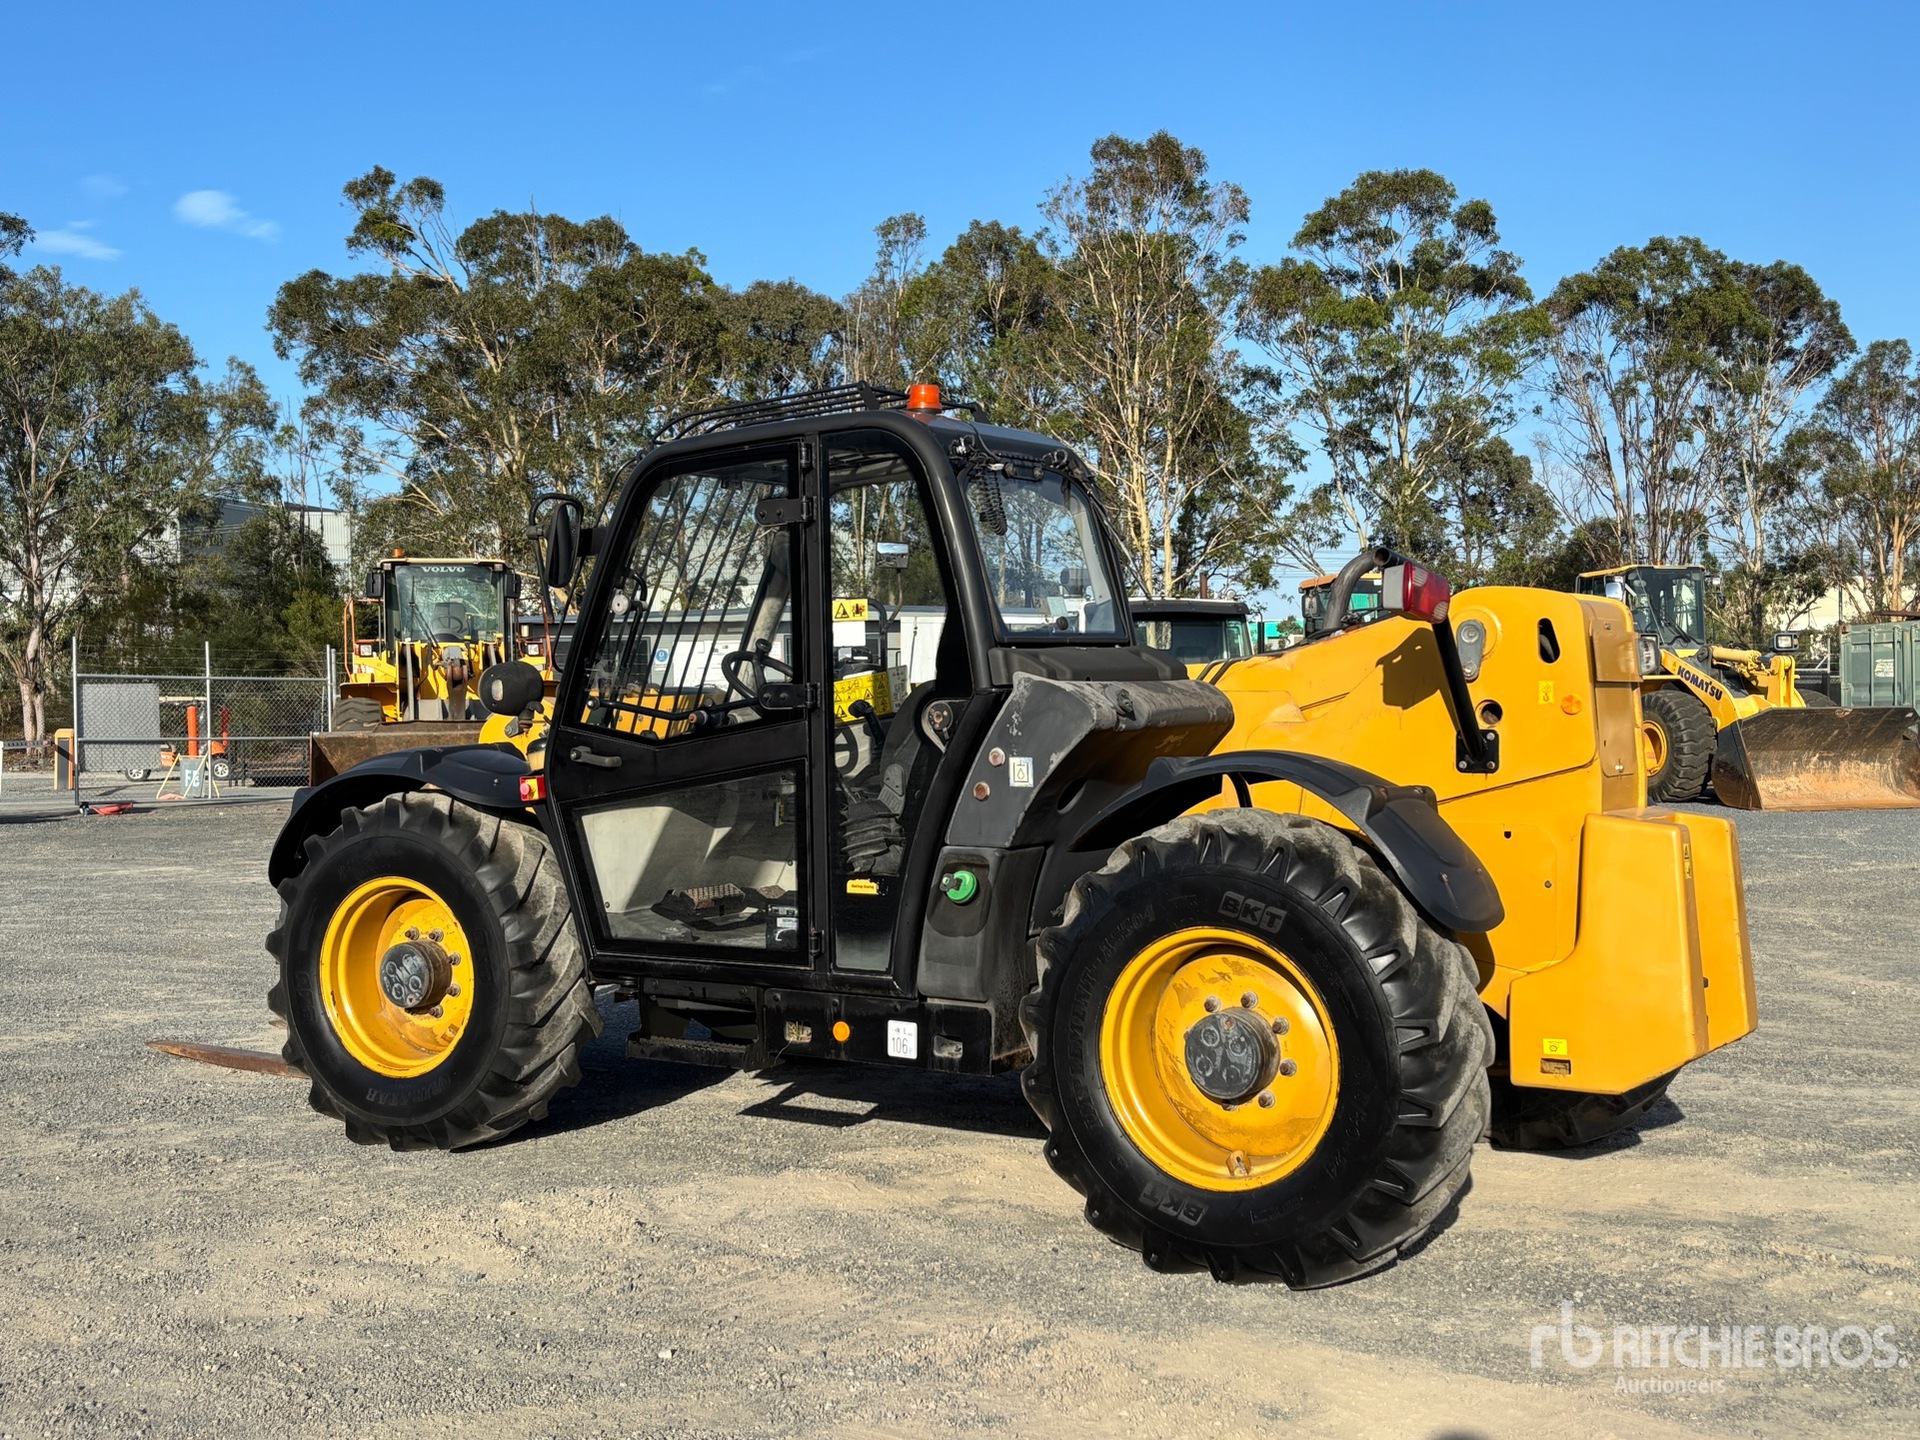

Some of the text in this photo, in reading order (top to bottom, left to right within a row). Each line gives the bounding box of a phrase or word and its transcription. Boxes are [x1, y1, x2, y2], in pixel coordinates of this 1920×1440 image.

[1677, 665, 1723, 701] KOMATSU
[1219, 892, 1285, 931] BKT
[892, 1037, 908, 1055] 106
[1140, 1180, 1207, 1225] BKT
